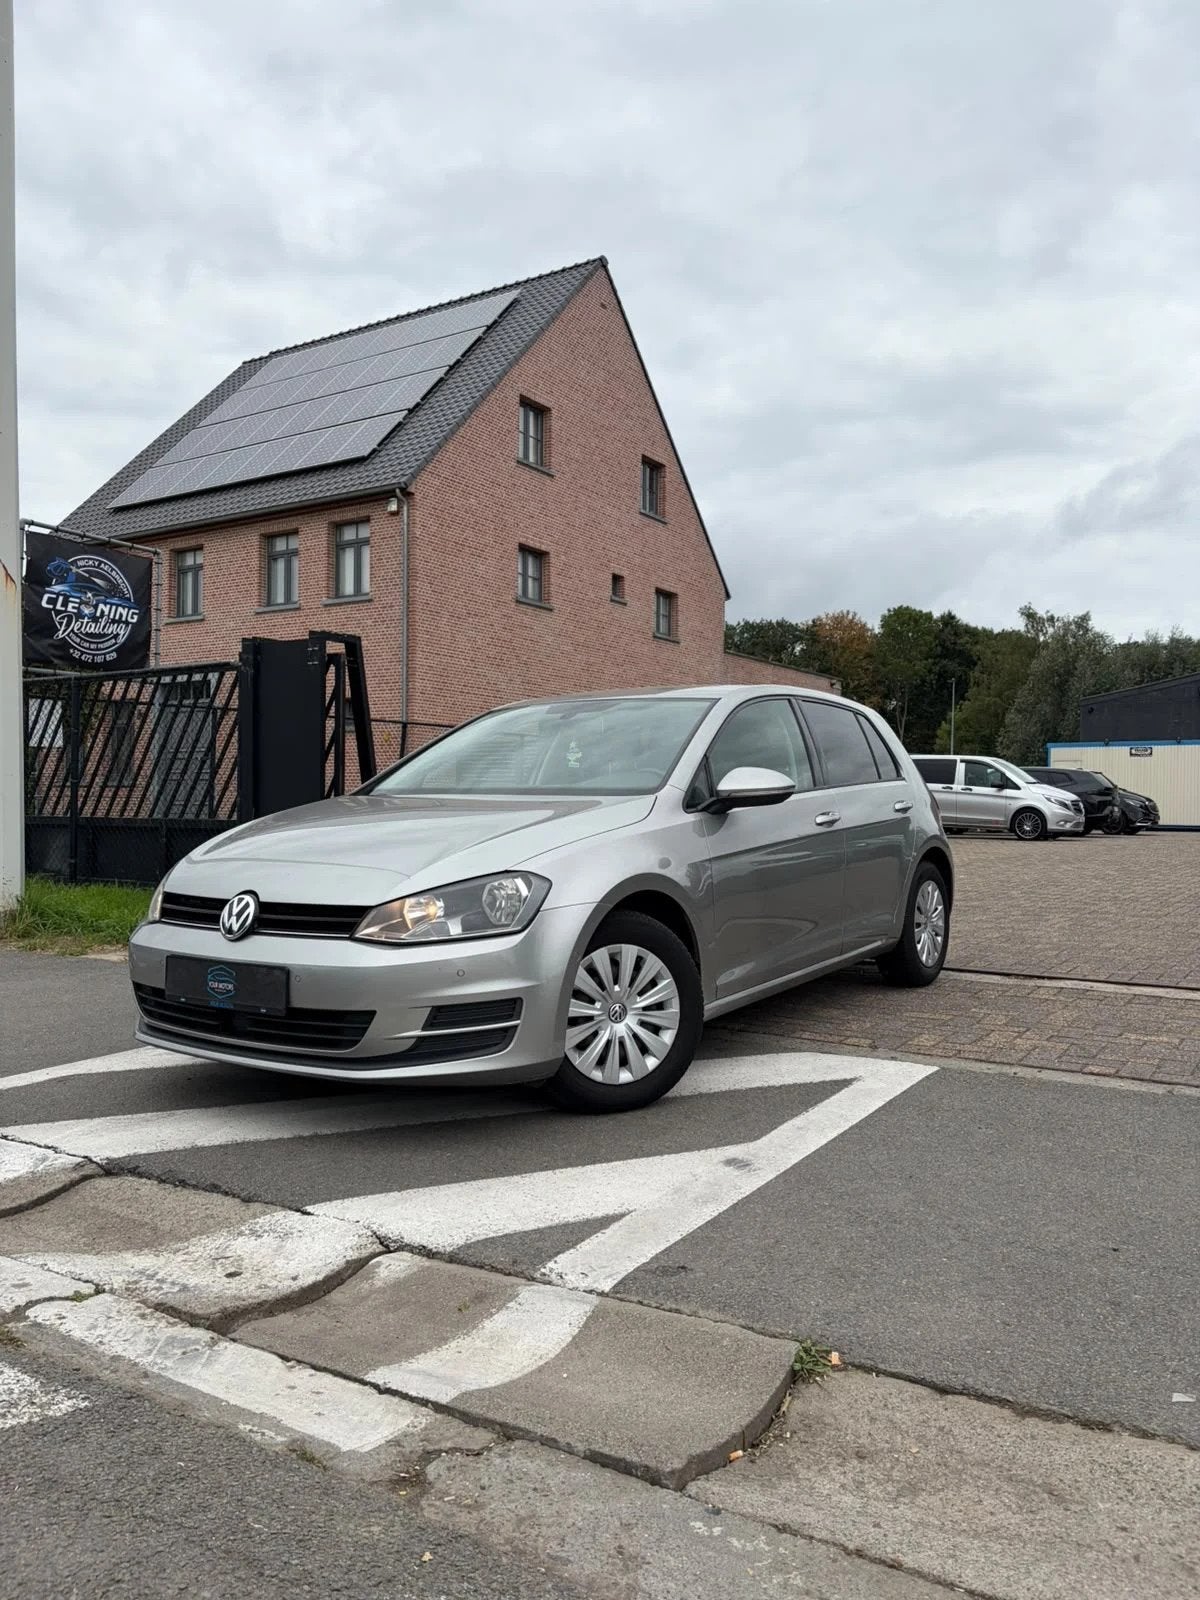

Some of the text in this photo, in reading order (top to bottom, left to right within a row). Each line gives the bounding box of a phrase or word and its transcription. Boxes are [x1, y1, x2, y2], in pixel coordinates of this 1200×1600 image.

[76, 559, 130, 598] NICKY AELBRECHT
[53, 612, 131, 644] Detailing
[69, 648, 81, 659] +32
[80, 653, 93, 663] 472
[79, 640, 90, 649] CAR
